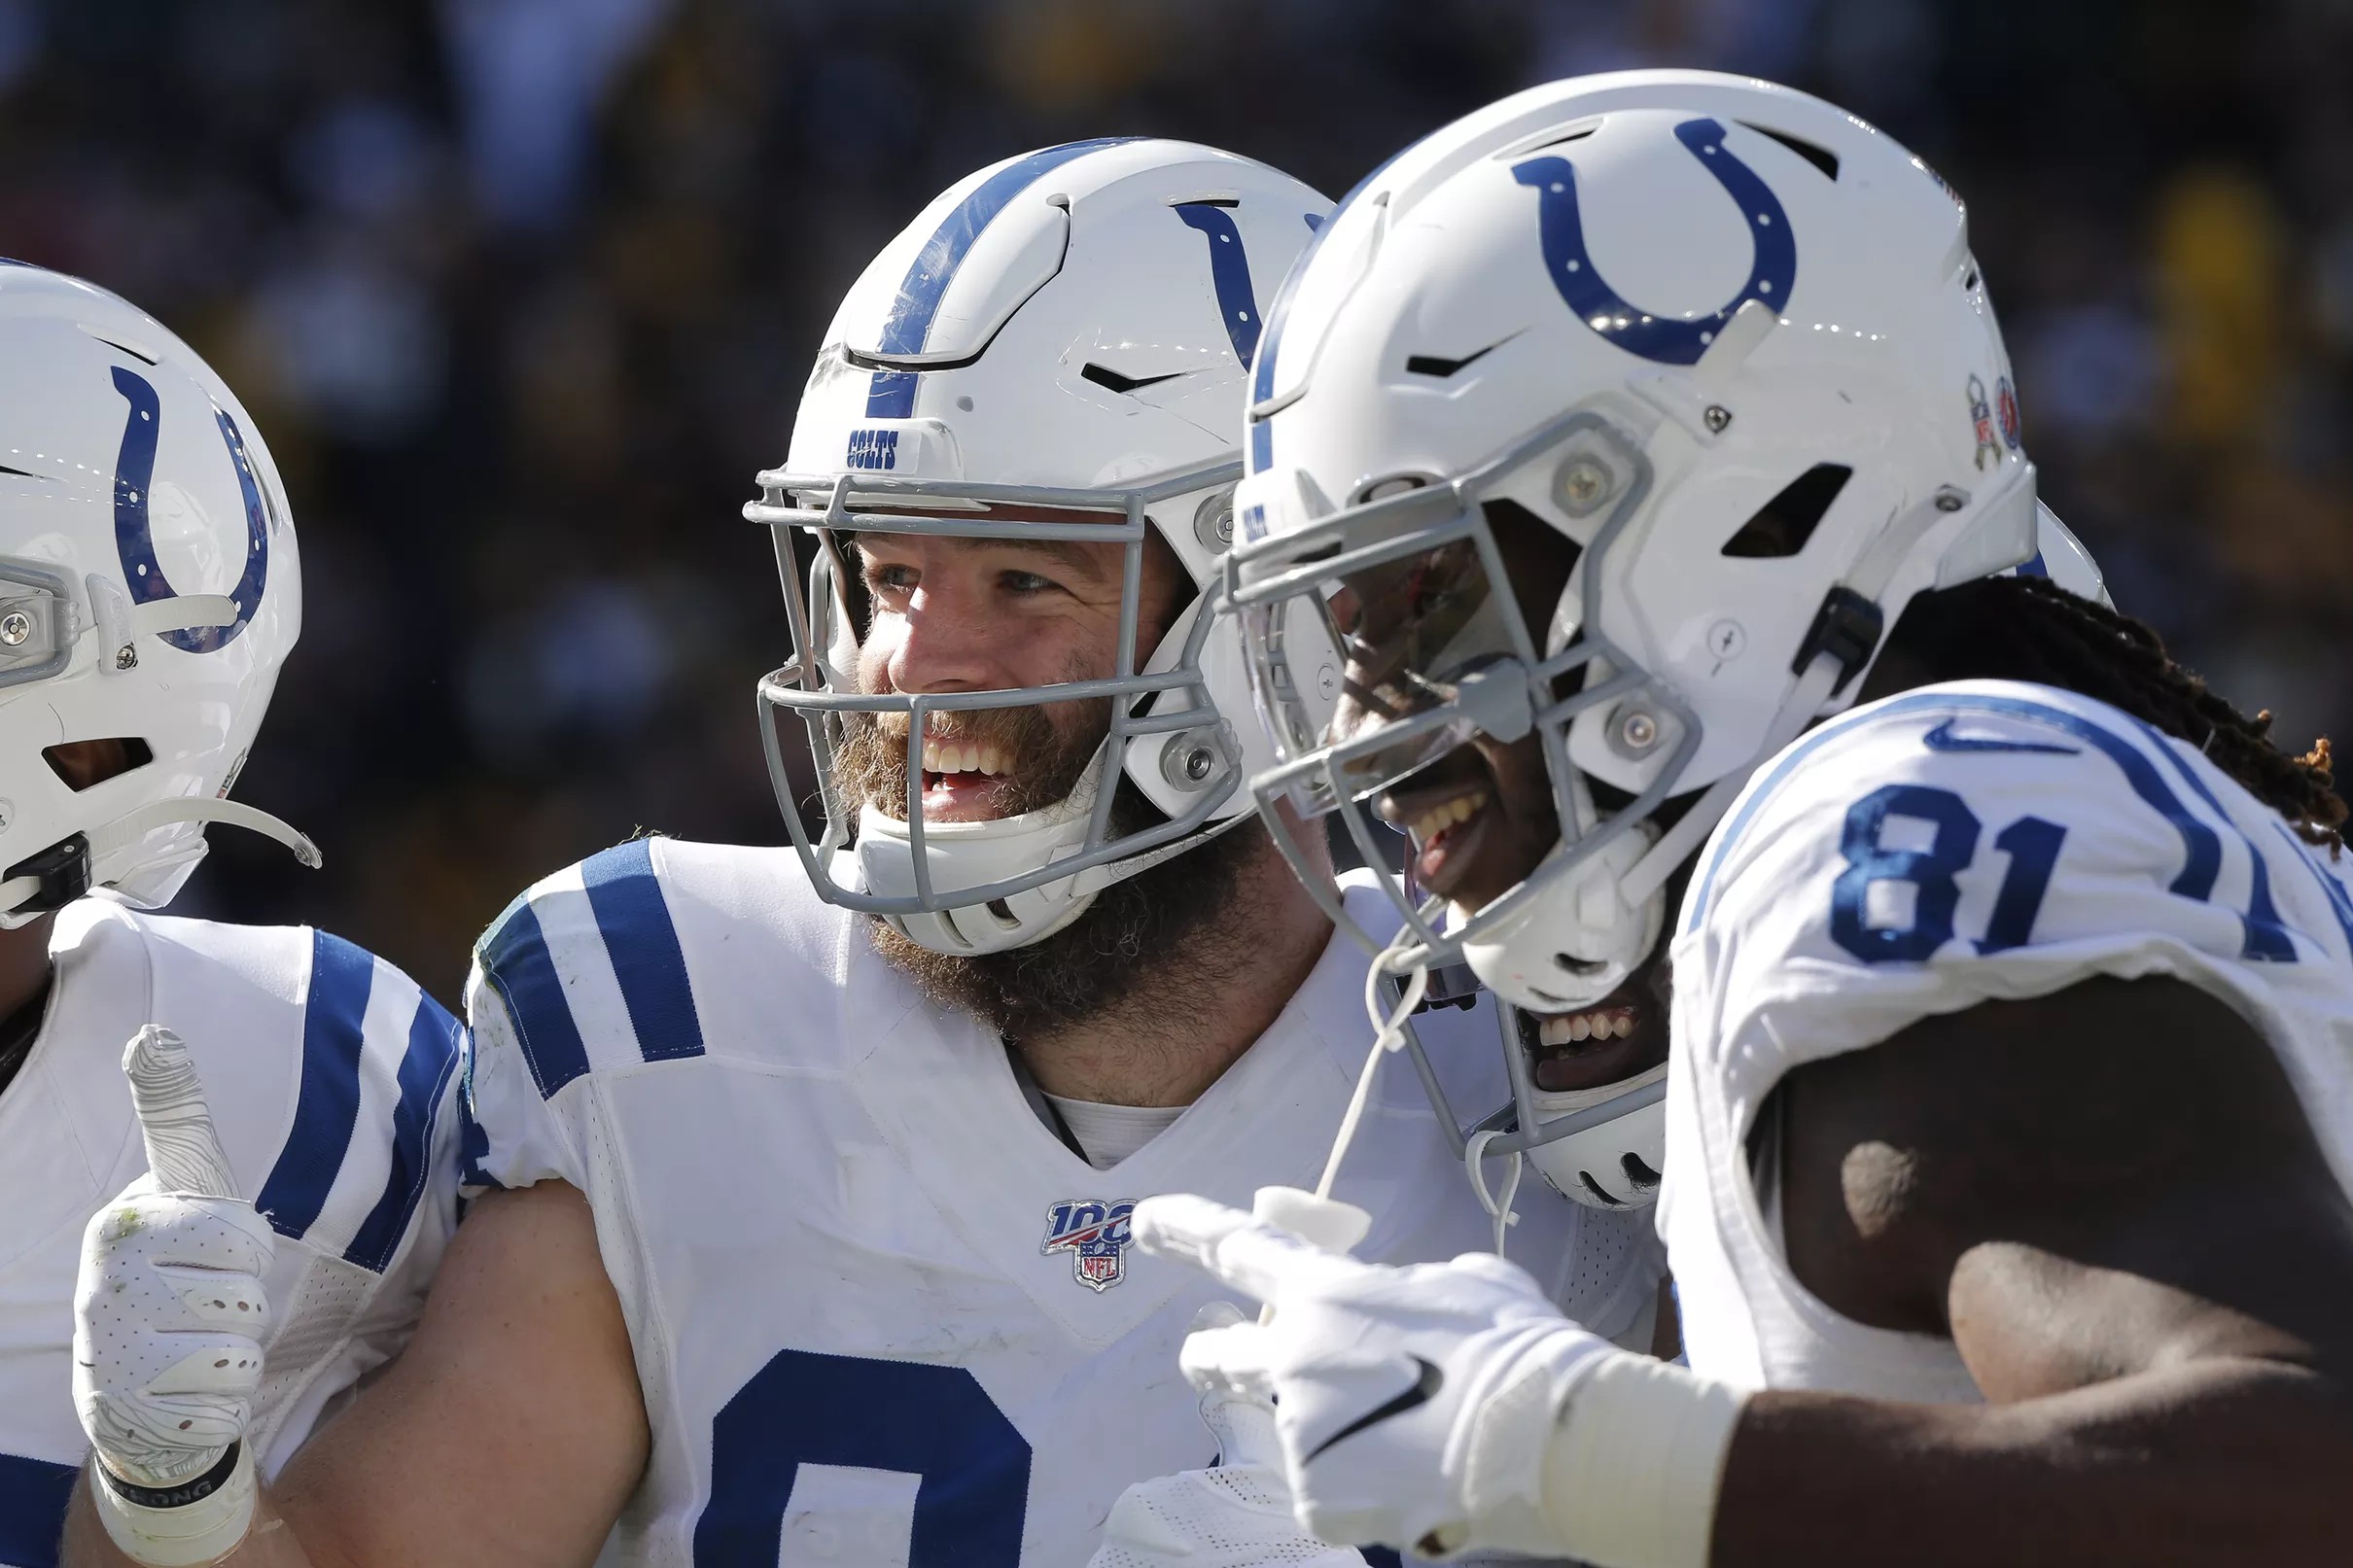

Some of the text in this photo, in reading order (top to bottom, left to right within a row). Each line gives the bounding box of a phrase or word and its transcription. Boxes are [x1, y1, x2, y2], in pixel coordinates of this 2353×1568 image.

[847, 430, 898, 470] COLTS
[1830, 784, 2068, 963] 81
[1083, 1257, 1116, 1279] NFL
